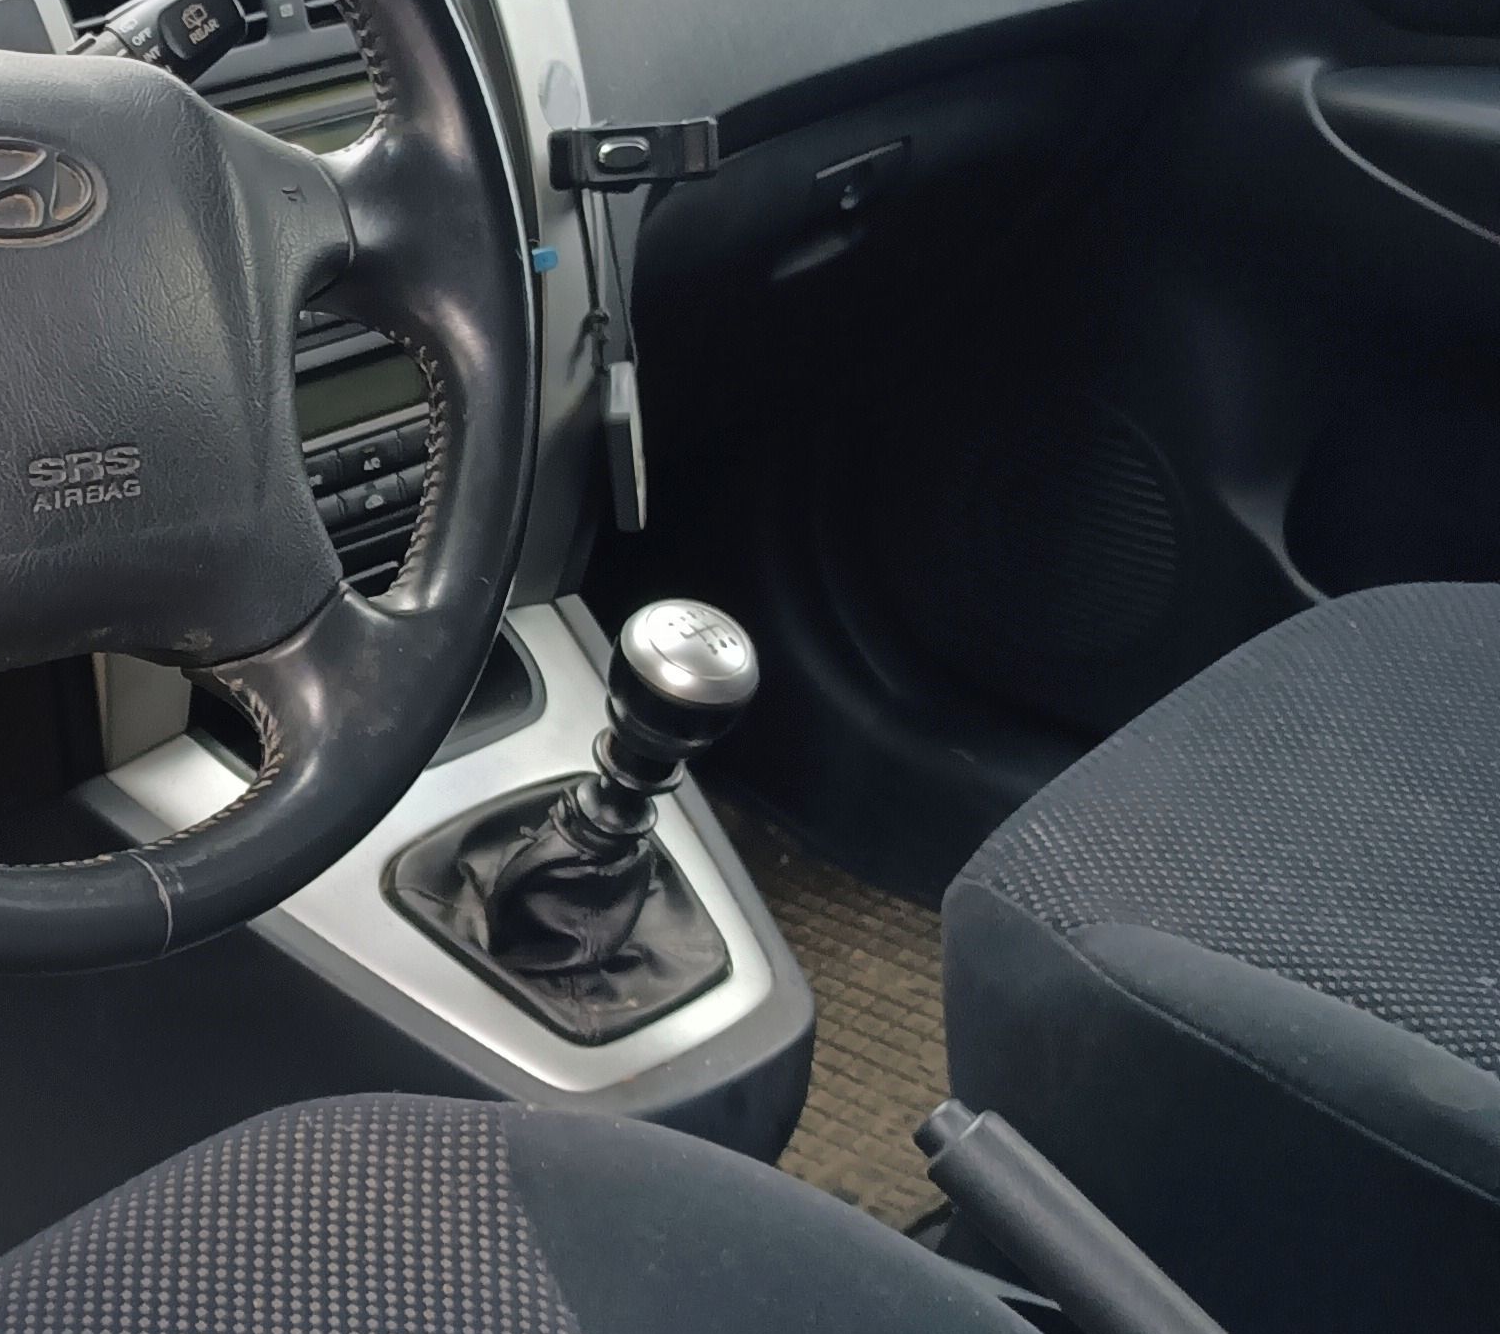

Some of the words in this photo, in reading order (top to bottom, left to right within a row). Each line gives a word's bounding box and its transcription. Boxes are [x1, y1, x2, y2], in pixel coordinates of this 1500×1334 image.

[131, 27, 153, 47] OFF
[189, 19, 220, 45] REAR
[28, 446, 141, 487] SRS
[33, 479, 141, 513] AIRBAG
